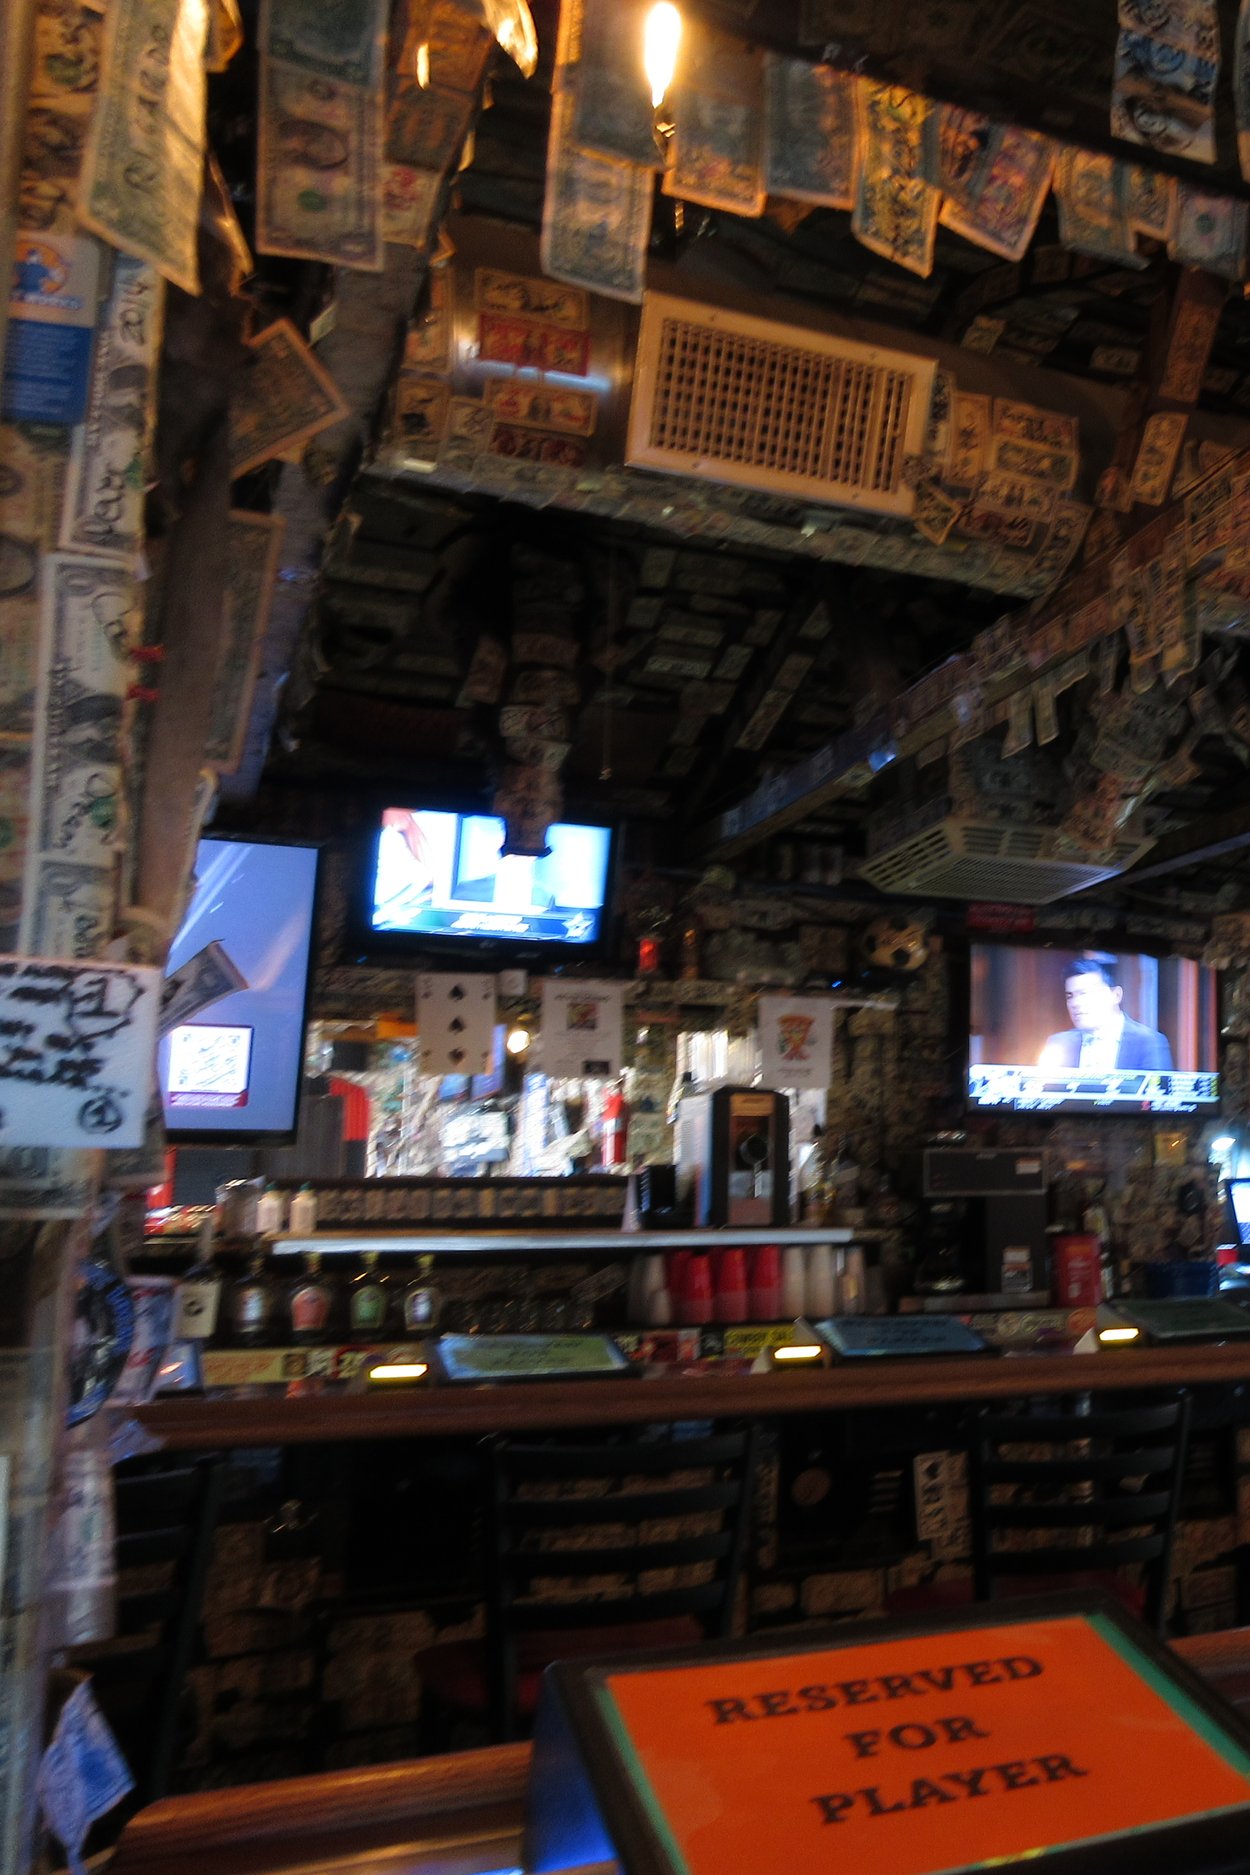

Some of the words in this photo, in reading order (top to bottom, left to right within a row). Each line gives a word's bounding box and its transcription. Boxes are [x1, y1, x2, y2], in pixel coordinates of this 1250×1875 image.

[705, 1654, 1045, 1725] RESERVED
[845, 1715, 993, 1761] FOR
[810, 1751, 1091, 1827] PLAYER
